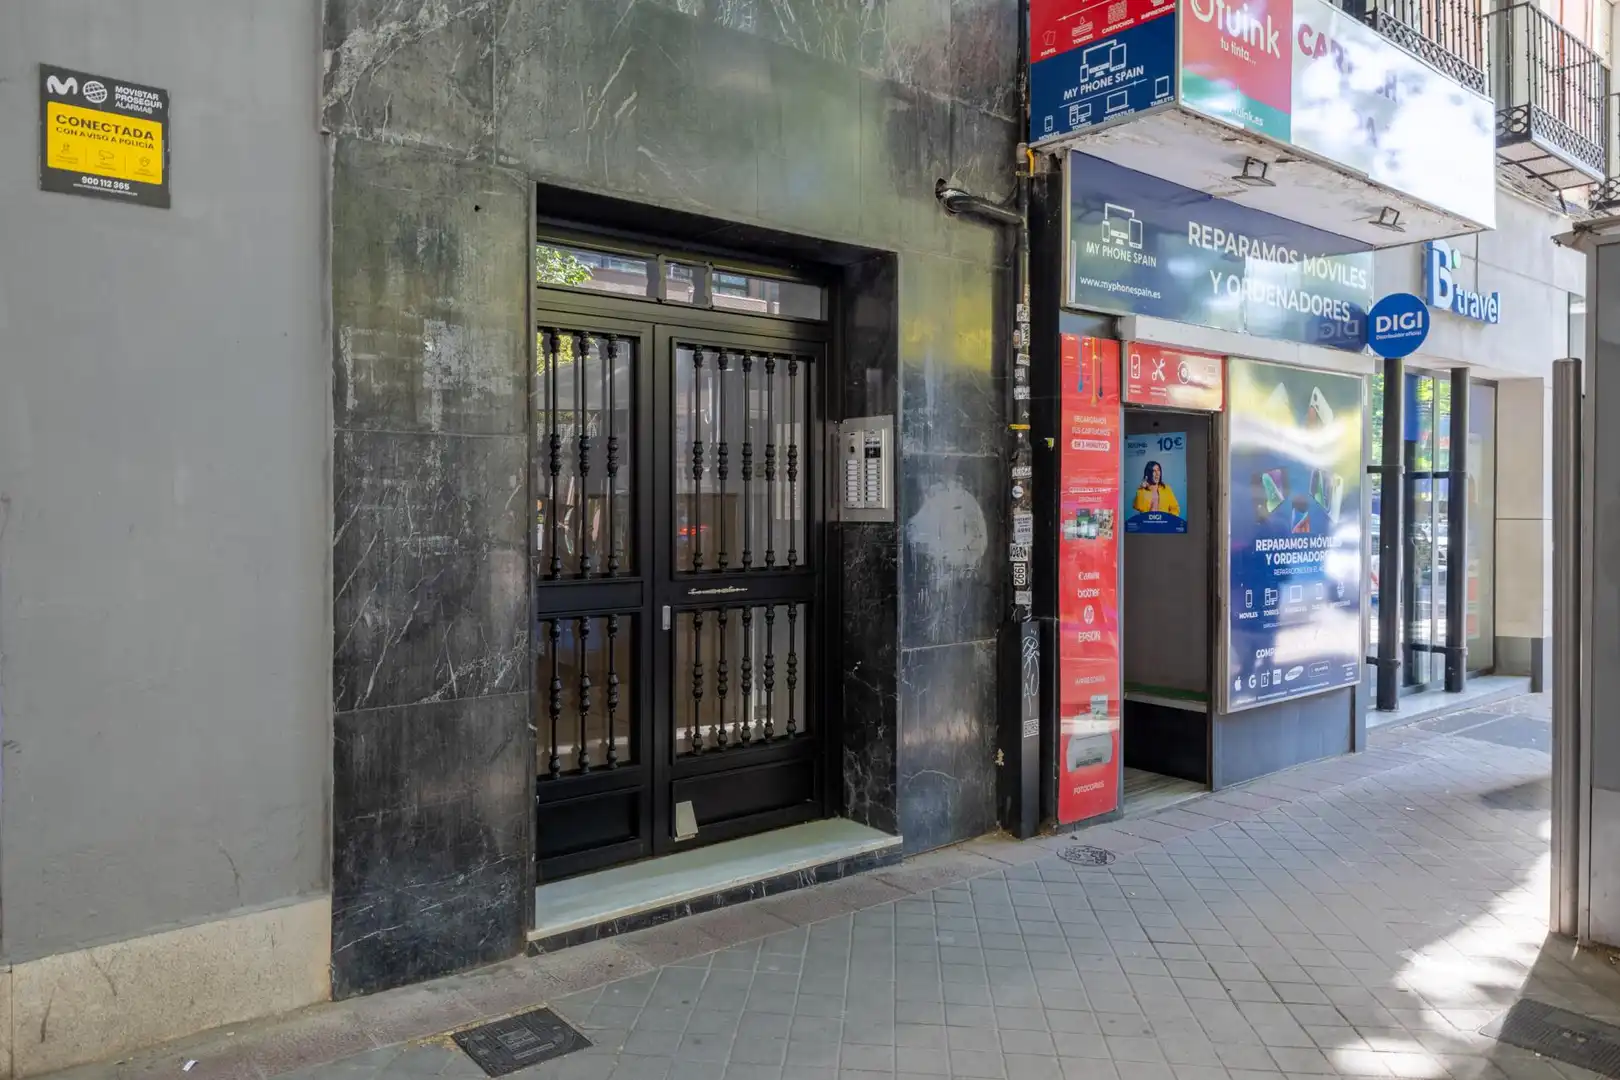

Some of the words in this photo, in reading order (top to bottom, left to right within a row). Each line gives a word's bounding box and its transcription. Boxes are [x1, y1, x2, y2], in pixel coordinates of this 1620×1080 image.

[1102, 18, 1135, 34] CARTUCHOS
[1041, 47, 1057, 57] PAPEL
[1220, 37, 1230, 52] tu
[1063, 87, 1078, 100] MY
[1080, 75, 1113, 95] PHONE
[1115, 65, 1144, 83] SPAIN
[115, 85, 159, 100] MOVISTAR
[115, 93, 162, 109] PROSEGUR
[115, 101, 153, 114] ALARMAS
[1150, 95, 1174, 107] TABLETS
[56, 114, 154, 140] CONECTADA
[56, 126, 77, 136] CON
[80, 129, 109, 142] AVISO
[82, 176, 99, 185] 900
[100, 179, 112, 188] 112
[113, 181, 130, 190] 365
[1086, 241, 1100, 256] MY
[1102, 245, 1132, 263] PHONE
[1133, 252, 1157, 267] SPAIN
[1188, 220, 1299, 272] REPARAMOS
[1303, 253, 1367, 290] MÓVILES
[1426, 240, 1453, 310] B
[1080, 276, 1161, 299] www.myphonespain.es
[1209, 269, 1222, 294] Y
[1226, 274, 1351, 321] ORDENADORES
[1453, 284, 1500, 324] travel
[1376, 311, 1423, 333] DIGI
[1256, 537, 1308, 551] REPARAMOS
[1265, 553, 1273, 565] Y
[1273, 550, 1329, 565] ORDENADOR
